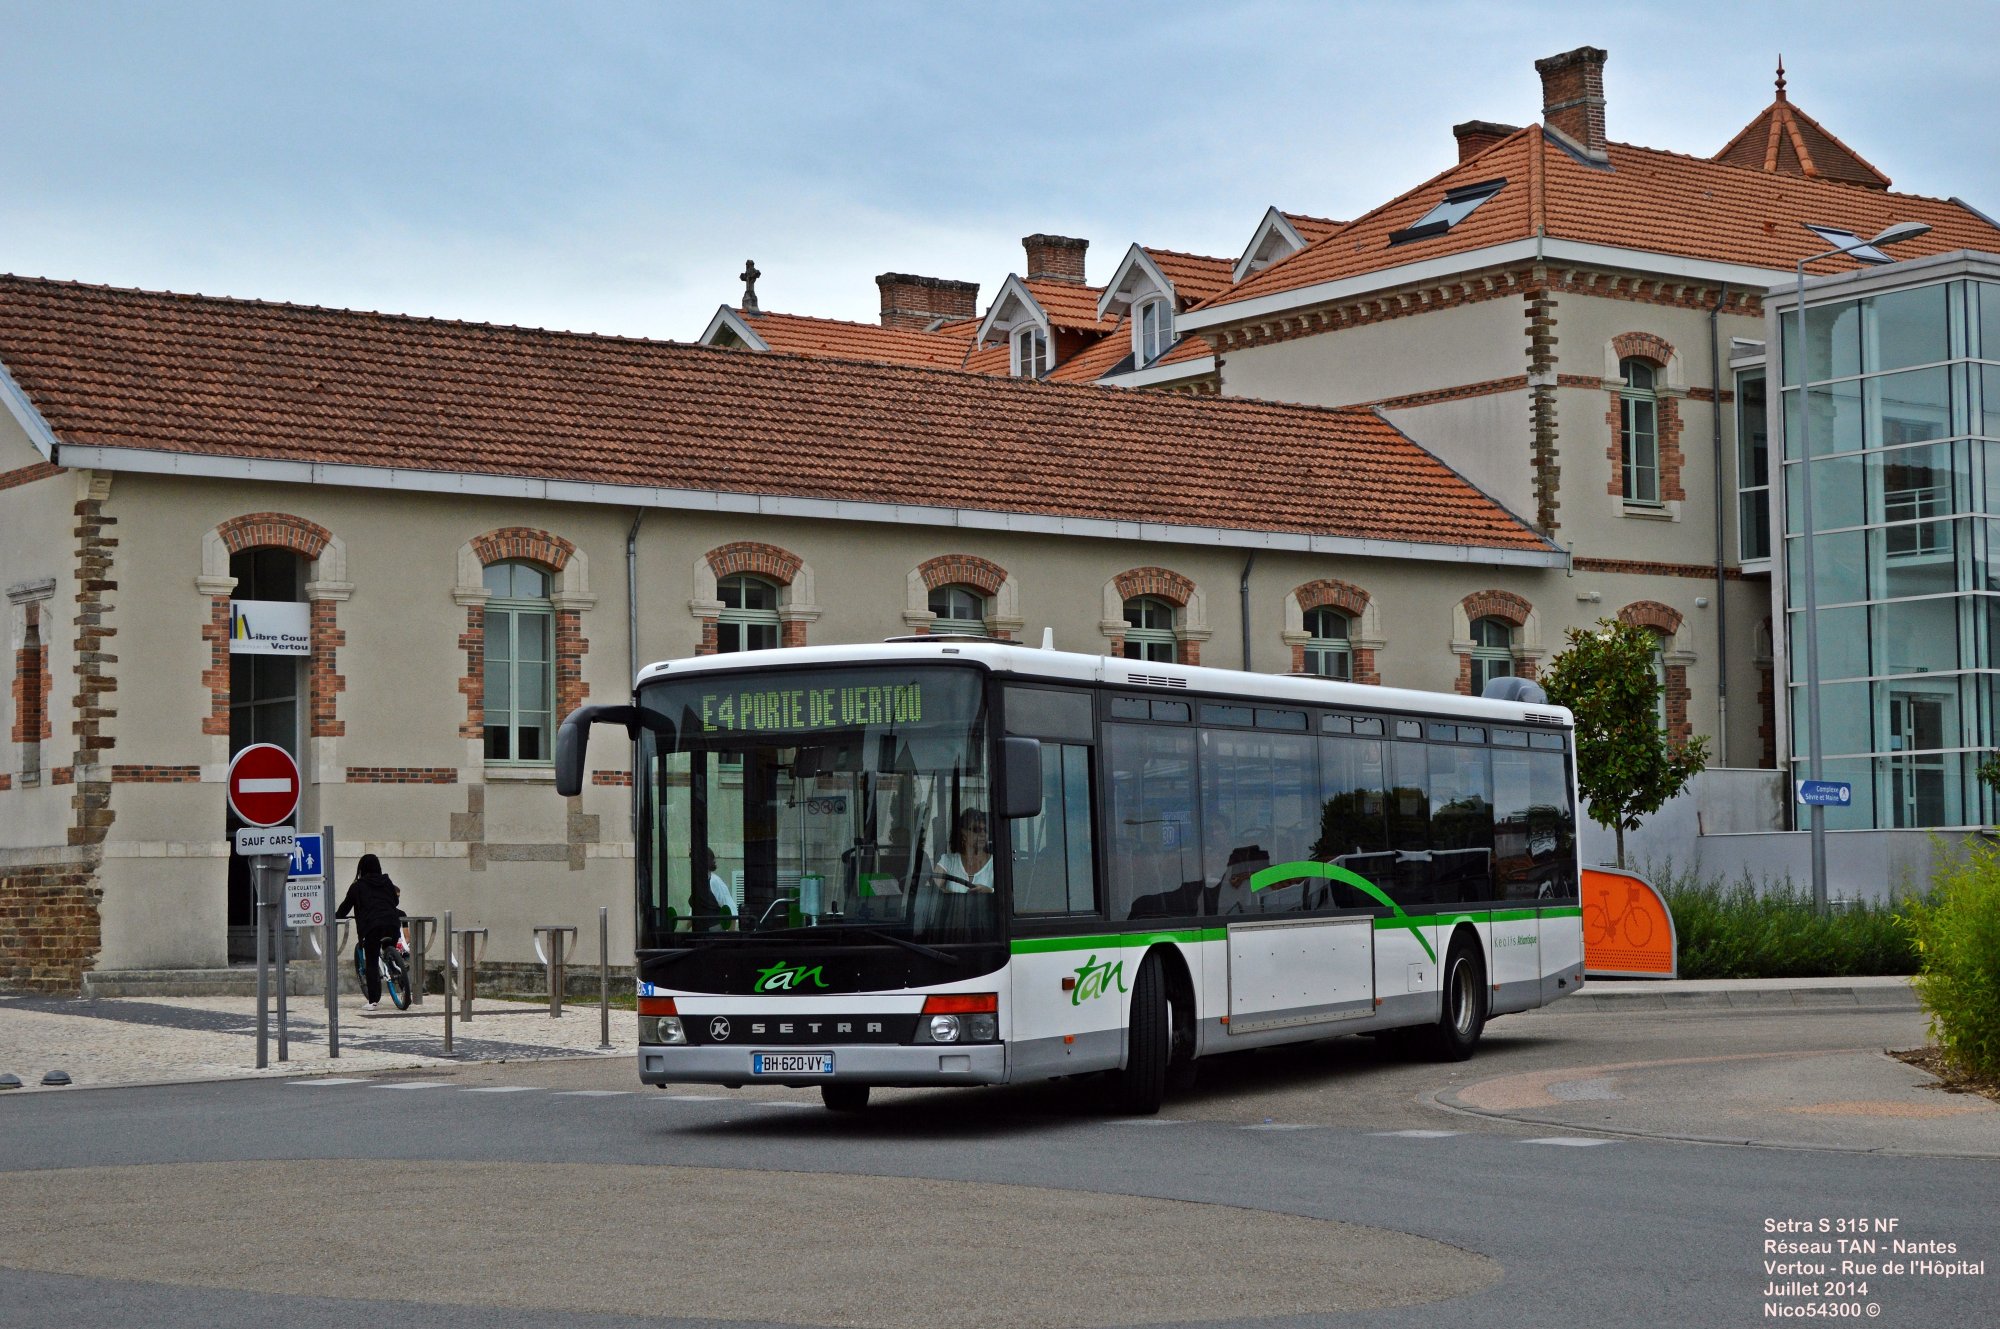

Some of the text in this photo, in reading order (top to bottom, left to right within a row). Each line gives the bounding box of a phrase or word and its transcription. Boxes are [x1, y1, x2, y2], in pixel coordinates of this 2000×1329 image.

[703, 684, 921, 731] E4 PORTE DE VERTOU
[1816, 785, 1839, 793] Complexe
[1805, 793, 1819, 801] Sèvre
[1825, 794, 1839, 802] Maine
[241, 835, 293, 847] SAUF CARS
[754, 961, 830, 993] tan
[1072, 954, 1129, 1006] tan
[752, 1022, 882, 1034] SETRA
[764, 1056, 822, 1071] BH-620-VY
